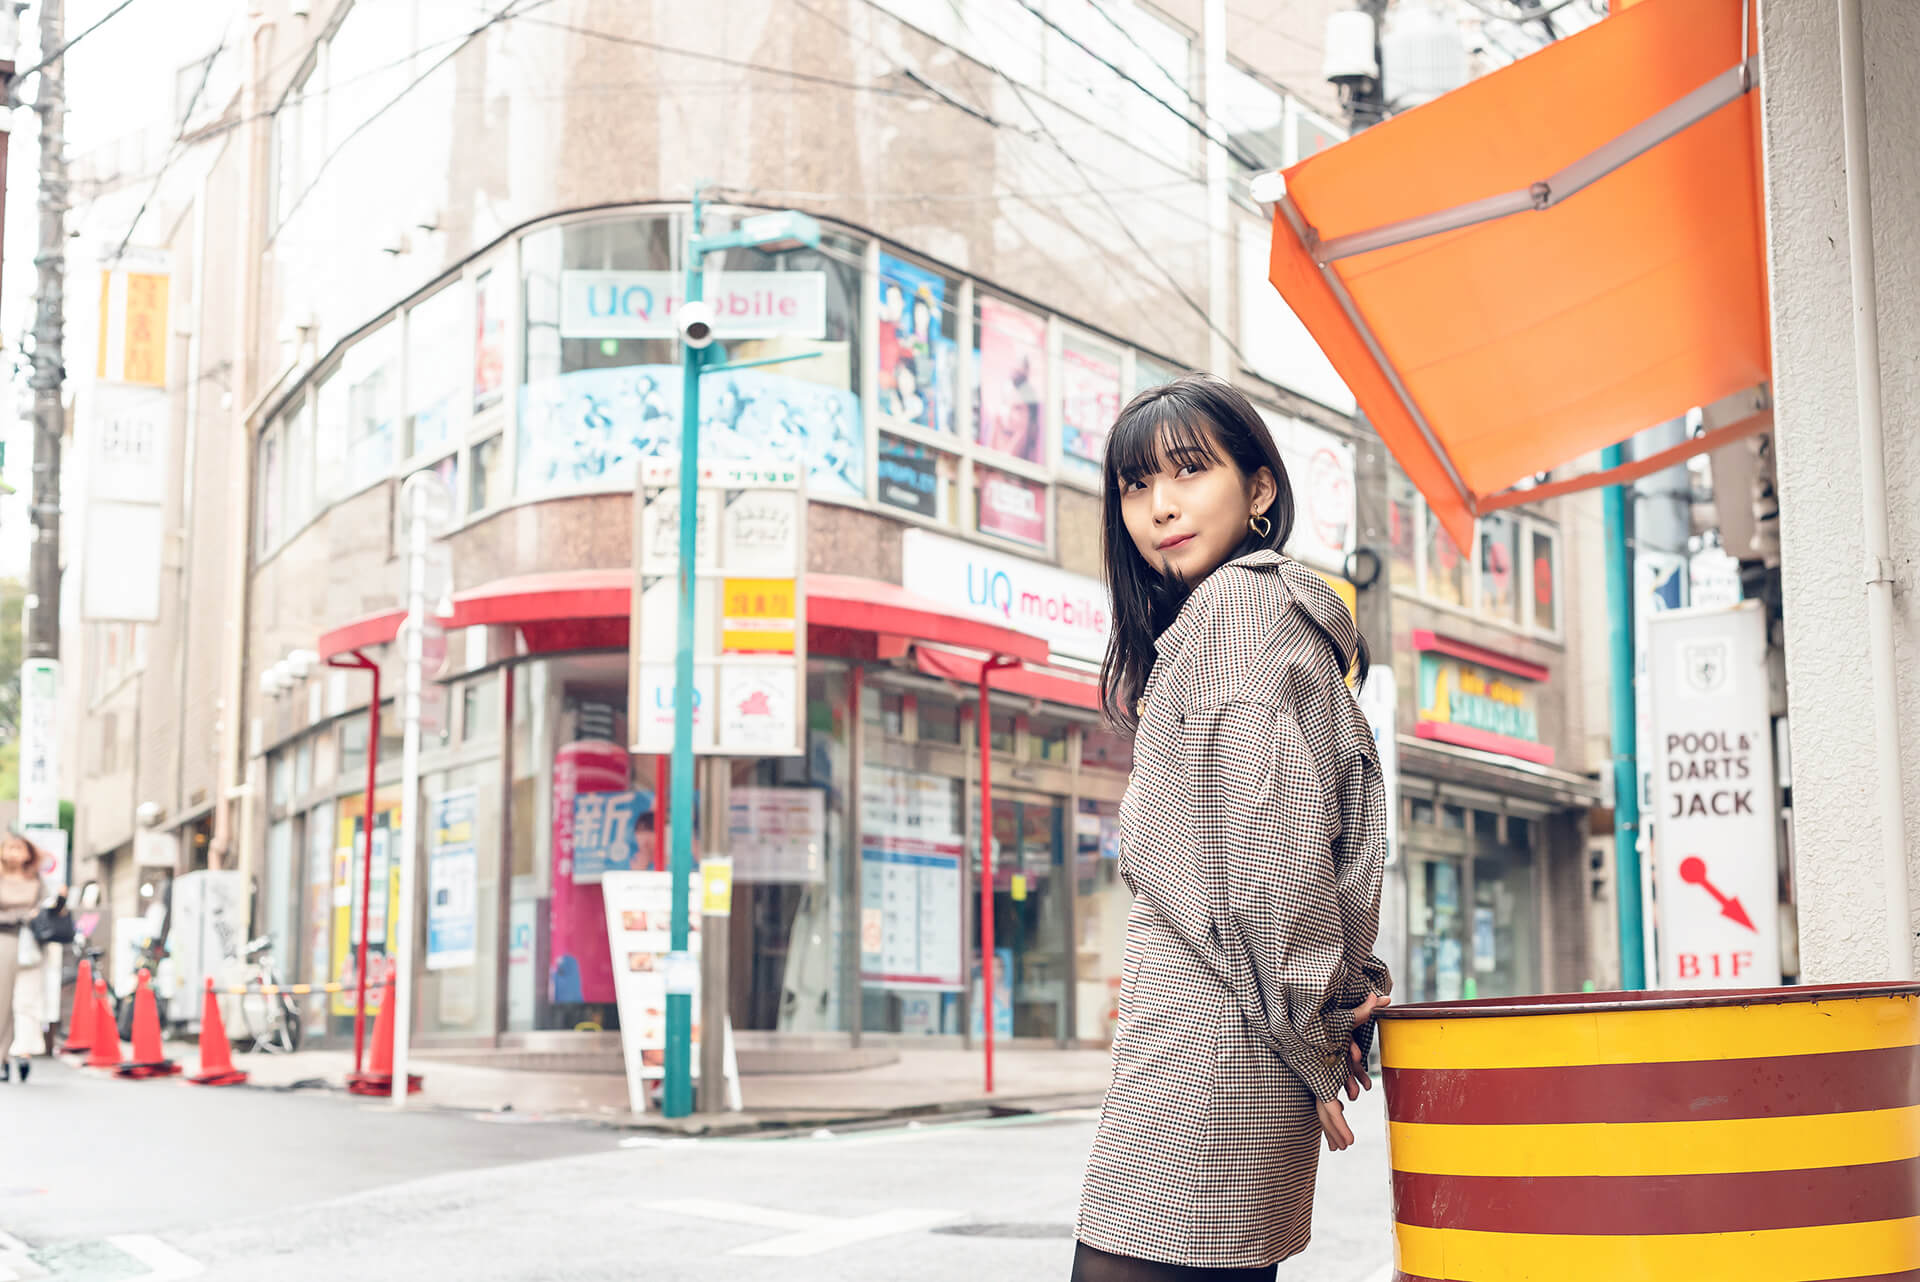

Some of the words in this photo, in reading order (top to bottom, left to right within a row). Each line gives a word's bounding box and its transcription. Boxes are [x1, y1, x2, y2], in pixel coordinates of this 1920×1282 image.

[588, 285, 653, 321] UQ
[968, 562, 1012, 618] UQ
[1021, 591, 1104, 633] mobile
[1667, 731, 1733, 754] POOL
[1739, 733, 1750, 750] &
[1668, 756, 1750, 782] DARTS
[1671, 790, 1752, 818] JACK
[1678, 950, 1753, 979] B1F
